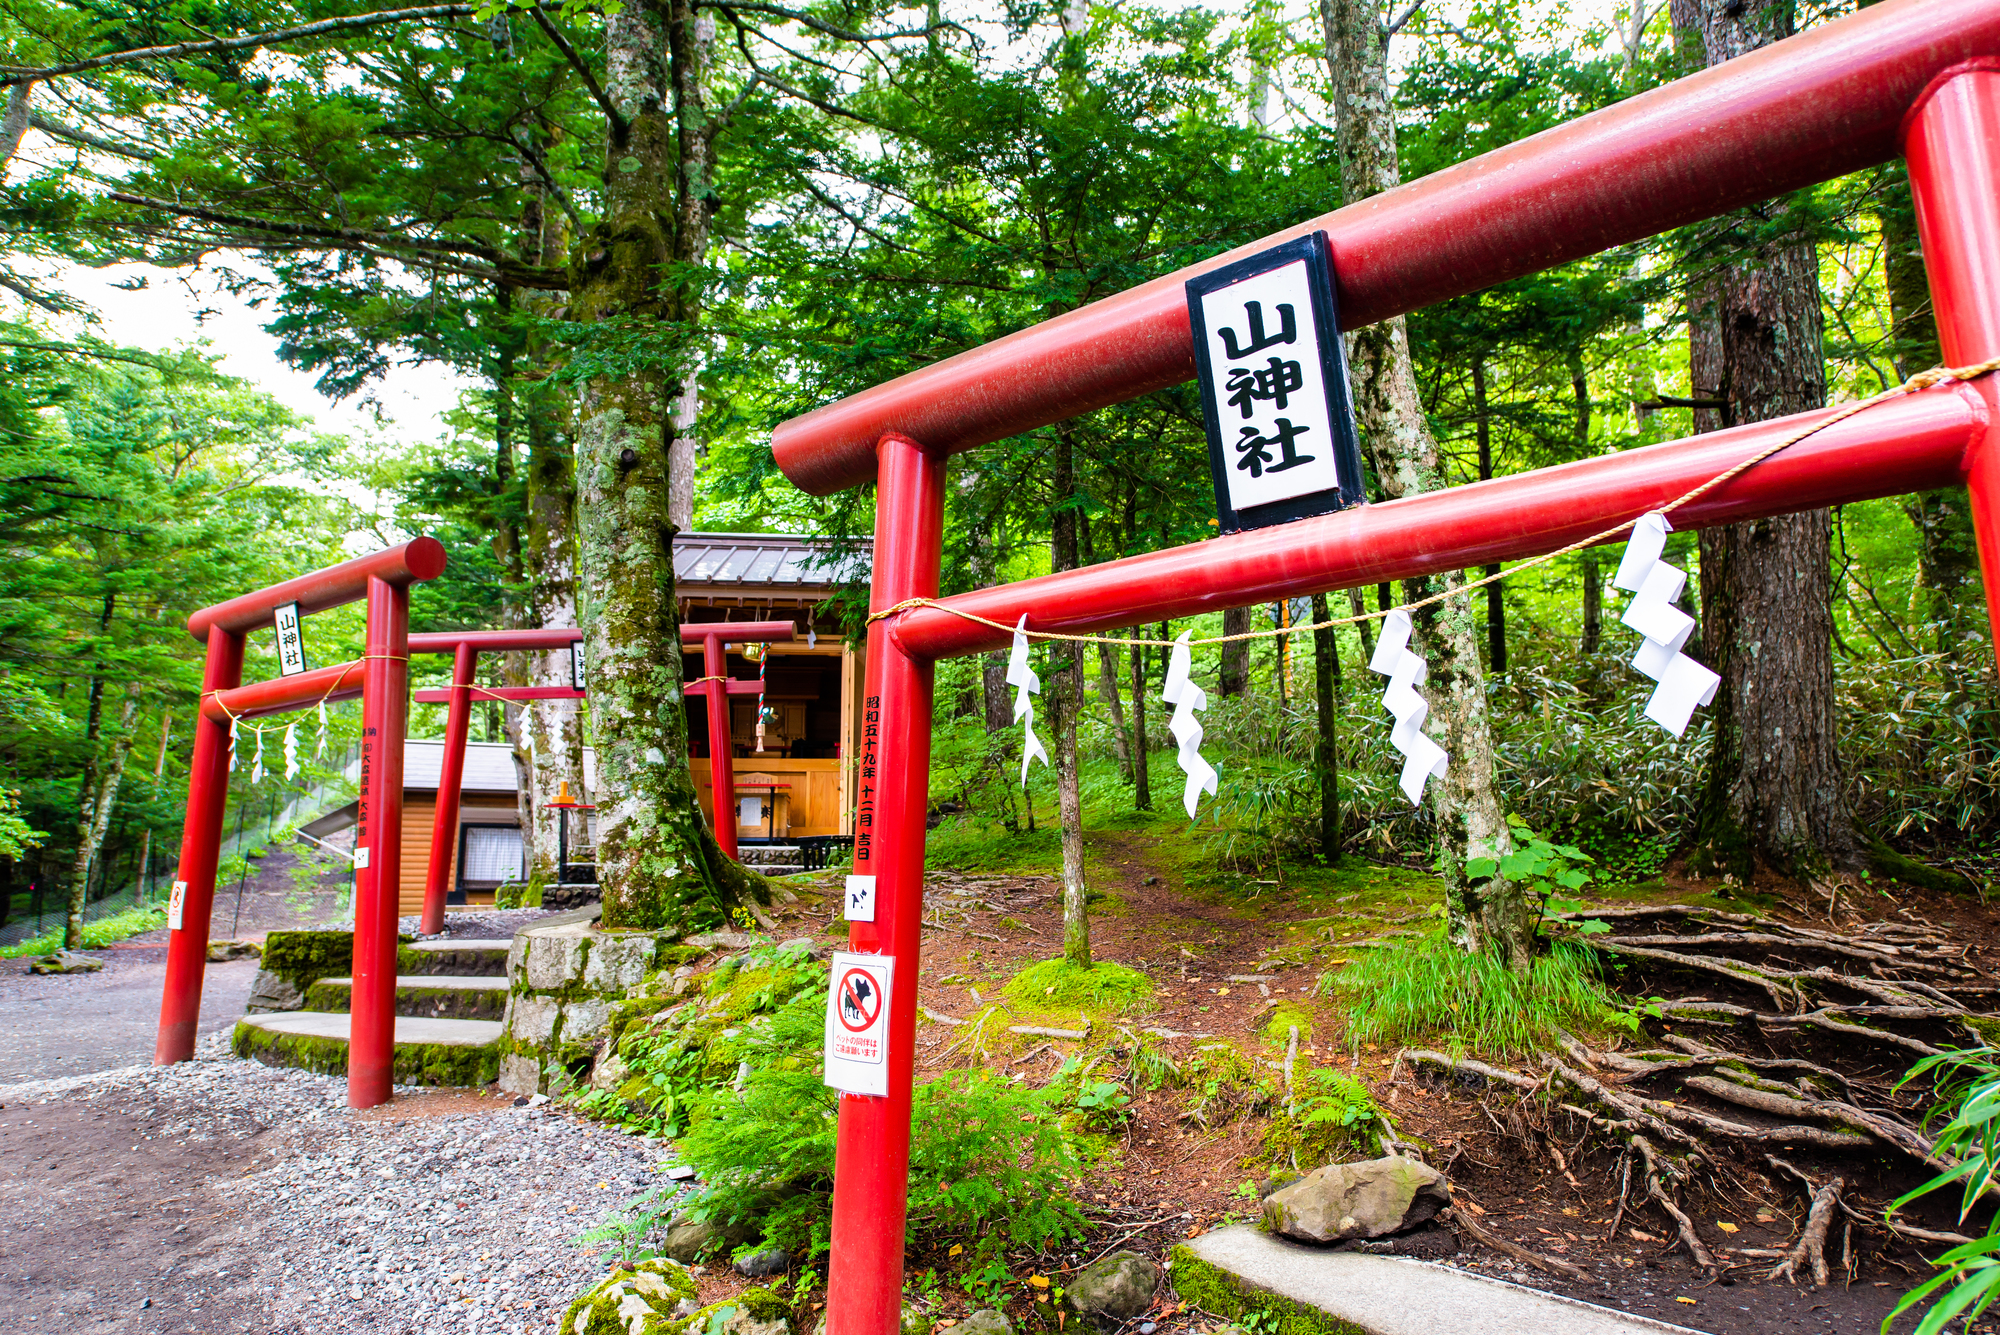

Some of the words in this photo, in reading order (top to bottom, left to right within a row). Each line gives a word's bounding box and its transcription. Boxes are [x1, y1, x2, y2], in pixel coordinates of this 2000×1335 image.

[1217, 300, 1316, 479] 山神社
[280, 614, 300, 667] 山神社
[862, 695, 880, 779] 昭和五十九年
[859, 785, 874, 827] 十二月
[857, 832, 871, 860] 吉日
[835, 1043, 878, 1058] ご遠慮願います
[836, 1034, 877, 1048] ペットの同伴は
